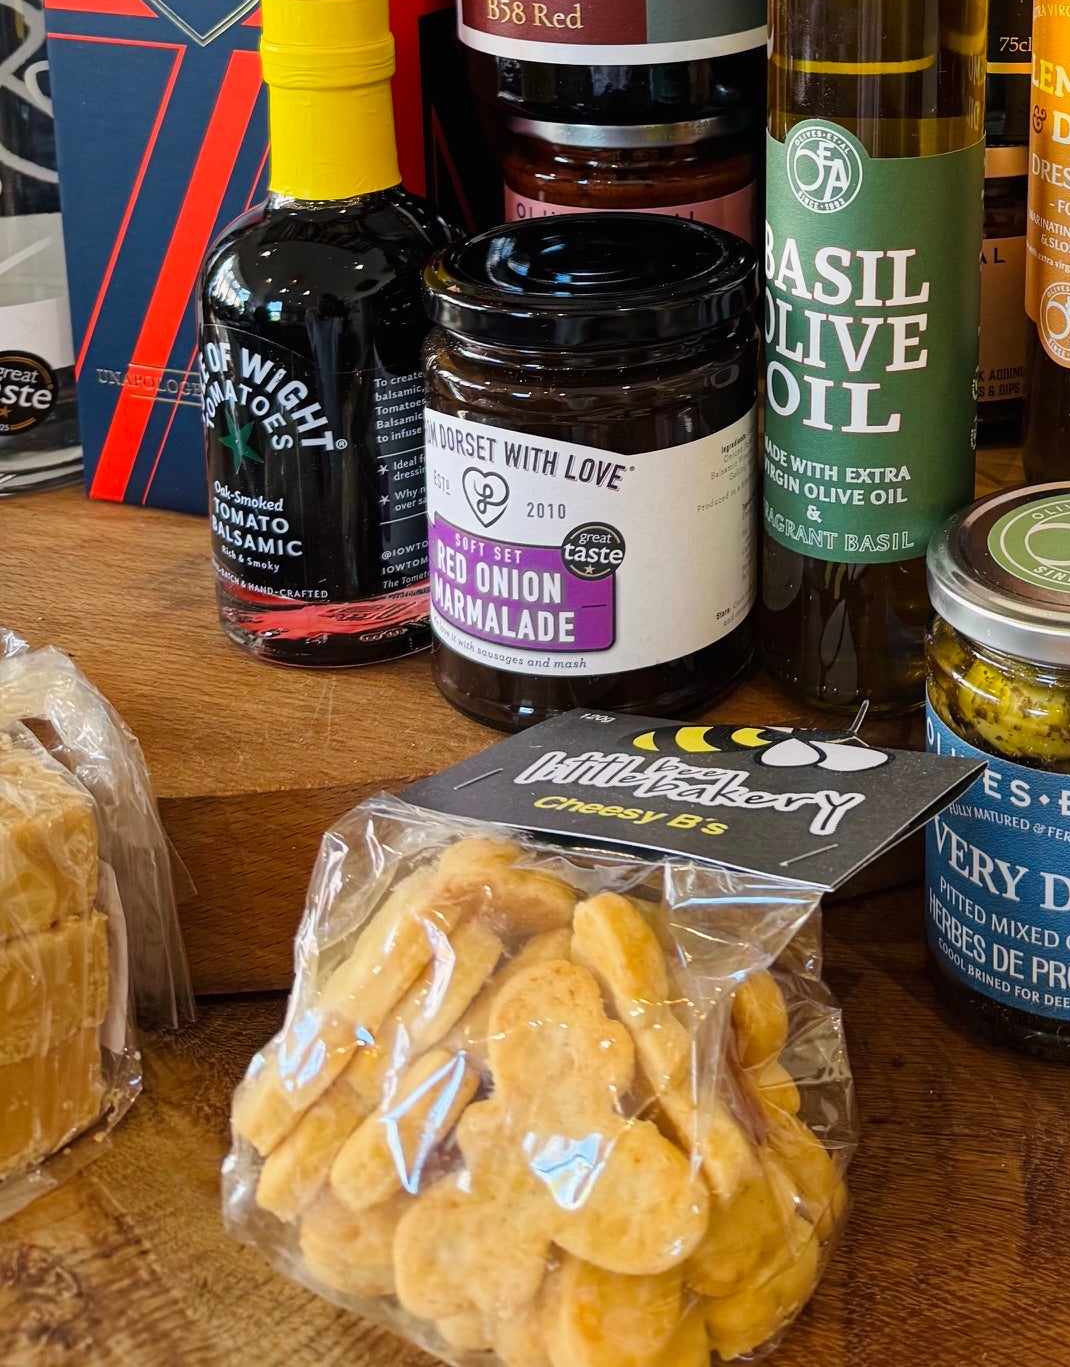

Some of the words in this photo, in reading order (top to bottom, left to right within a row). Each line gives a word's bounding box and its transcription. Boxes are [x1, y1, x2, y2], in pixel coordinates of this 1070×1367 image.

[532, 2, 584, 30] Red
[1000, 36, 1032, 52] 75cl
[765, 219, 931, 308] BASIL
[767, 360, 902, 433] OIL
[205, 379, 294, 451] TOMATOES
[438, 423, 497, 463] DORSET
[504, 441, 559, 477] WITH
[565, 454, 627, 491] LOVE
[790, 454, 838, 482] WITH
[845, 465, 912, 484] EXTRA
[213, 480, 284, 512] Oak-Smoked
[527, 501, 567, 519] 2010
[803, 482, 865, 506] OLIVE
[213, 496, 290, 534] TOMATO
[211, 514, 304, 557] BALSAMIC
[455, 535, 485, 557] SOFT
[494, 546, 523, 564] SET
[844, 531, 914, 552] BASIL
[437, 538, 467, 585] RED
[476, 561, 563, 604] ONION
[564, 544, 624, 564] taste
[248, 582, 329, 599] HAND-CRAFTED
[434, 572, 576, 643] MARMALADE
[477, 646, 524, 666] sausages
[554, 658, 588, 669] mash
[533, 795, 668, 825] Cheesy
[666, 813, 729, 836] B's
[974, 807, 1031, 832] MATURED
[933, 816, 1030, 903] VERY
[940, 875, 986, 925] PITTED
[991, 912, 1060, 949] MIXED
[929, 887, 987, 967] HERBES
[992, 943, 1025, 980] DE
